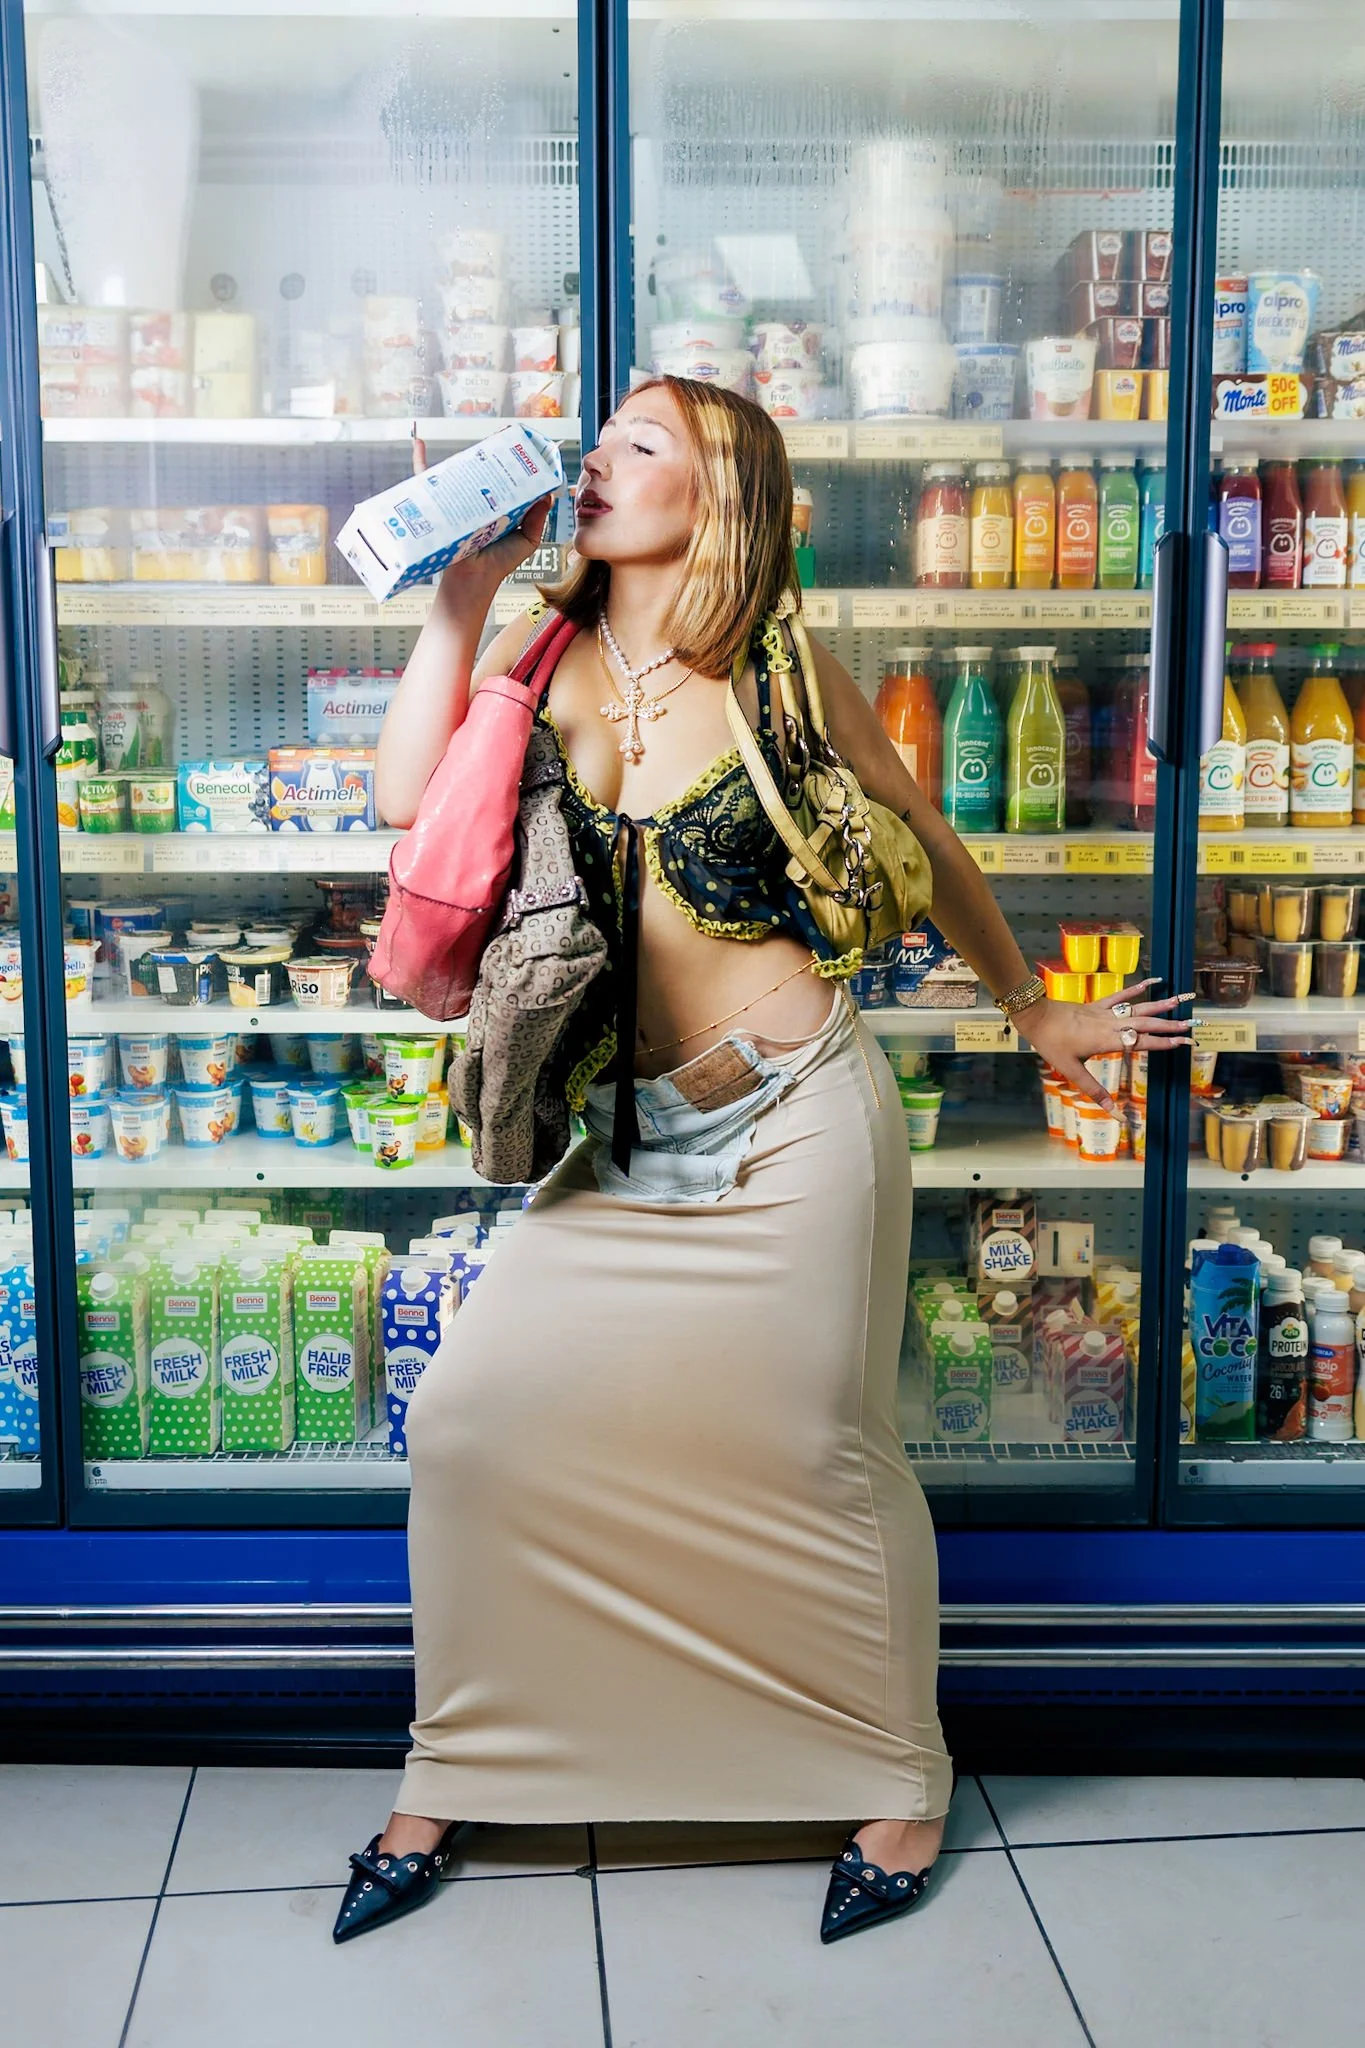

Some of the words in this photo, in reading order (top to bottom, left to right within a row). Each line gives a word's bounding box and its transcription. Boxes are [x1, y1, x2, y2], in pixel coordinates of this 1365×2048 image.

[1214, 303, 1245, 317] lpro
[1264, 294, 1303, 311] alpro
[1272, 378, 1297, 394] 50c
[1224, 388, 1266, 412] Monte
[1272, 397, 1297, 411] OFF
[513, 443, 539, 475] Benna
[322, 701, 388, 715] Actimel
[959, 739, 990, 748] innocent
[1026, 745, 1059, 753] innocent
[196, 782, 251, 795] Benecol
[989, 1243, 1024, 1258] MILK
[984, 1255, 1032, 1270] SHAKE
[236, 1296, 264, 1304] Benna
[309, 1294, 337, 1303] Benna
[397, 1308, 425, 1317] Benna
[1203, 1312, 1254, 1338] VITA
[1199, 1337, 1258, 1357] COCO
[1271, 1340, 1307, 1353] PROTEIN
[14, 1357, 39, 1373] FRE
[153, 1352, 202, 1372] FRESH
[224, 1349, 272, 1369] FRESH
[80, 1364, 127, 1383] FRESH
[160, 1366, 199, 1384] MILK
[231, 1363, 270, 1382] MILK
[308, 1362, 349, 1378] FRISK
[86, 1377, 125, 1395] MILK
[1227, 1375, 1252, 1383] WATER
[935, 1402, 982, 1419] FRESH
[1072, 1403, 1109, 1418] MILK
[942, 1415, 978, 1431] MILK
[1066, 1415, 1118, 1431] SHAKE
